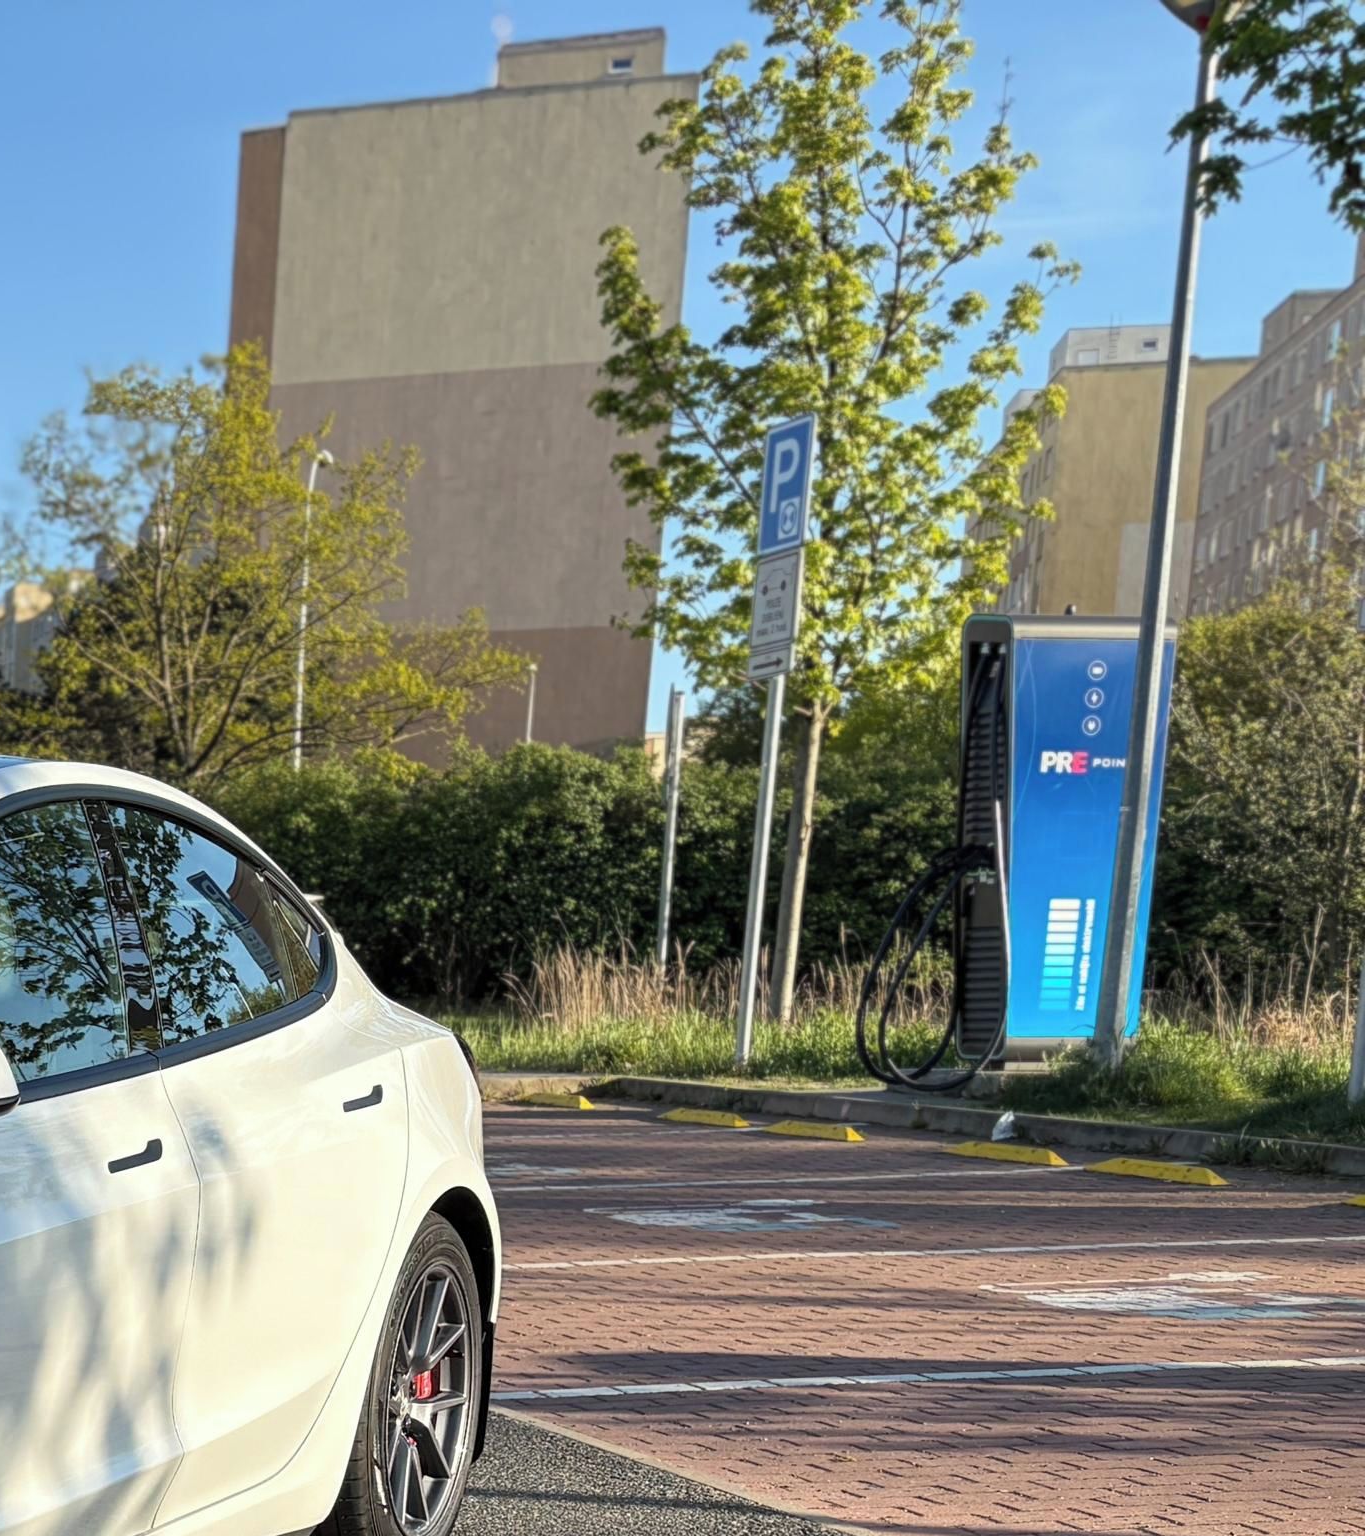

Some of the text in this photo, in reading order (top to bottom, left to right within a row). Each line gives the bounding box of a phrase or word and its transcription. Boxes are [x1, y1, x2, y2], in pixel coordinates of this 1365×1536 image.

[770, 438, 799, 513] P
[1040, 751, 1127, 774] PRE POIN
